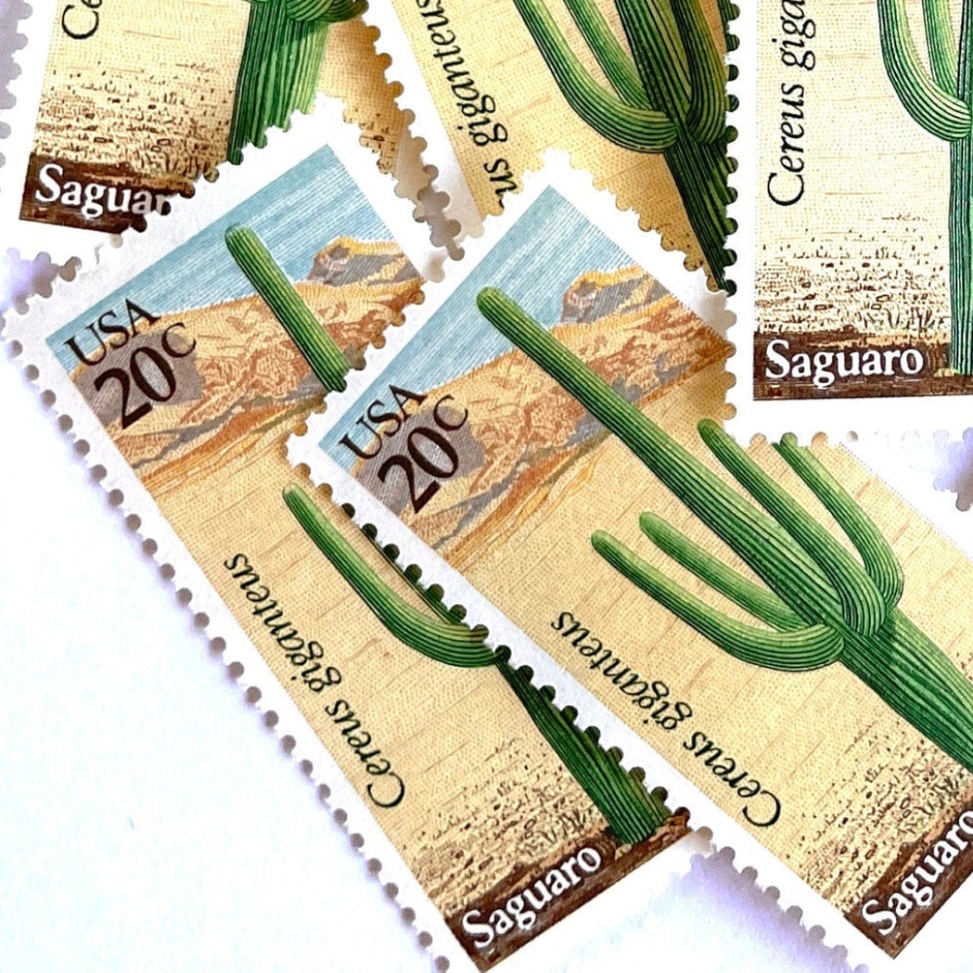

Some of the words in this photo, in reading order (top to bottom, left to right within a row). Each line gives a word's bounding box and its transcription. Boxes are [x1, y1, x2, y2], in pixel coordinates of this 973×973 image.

[35, 163, 167, 219] Saguar
[768, 83, 804, 206] Cereus
[64, 298, 160, 368] USA
[765, 340, 924, 388] Saguaro
[339, 384, 428, 461] USA
[224, 553, 342, 693] giganteus
[551, 611, 692, 732] giganteus
[326, 699, 405, 809] Cereus
[683, 732, 781, 828] Cereus
[461, 846, 601, 950] Saguaro
